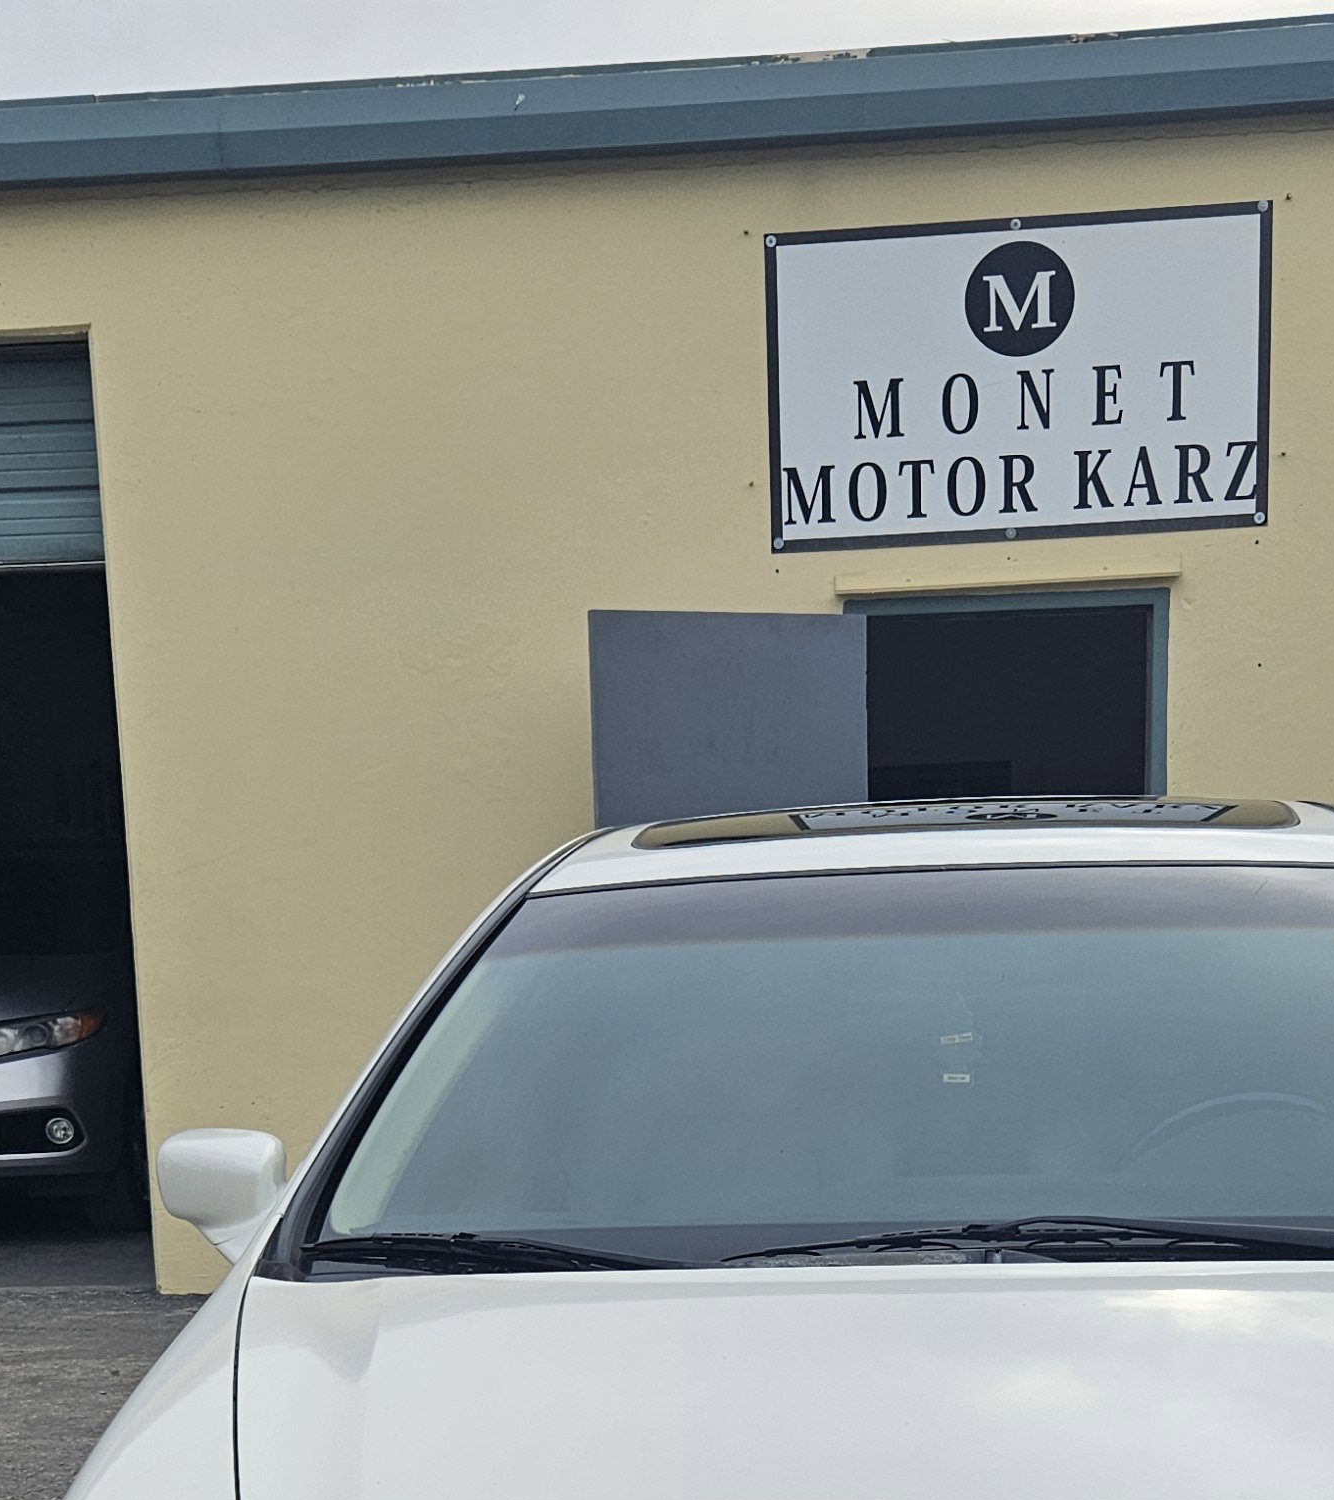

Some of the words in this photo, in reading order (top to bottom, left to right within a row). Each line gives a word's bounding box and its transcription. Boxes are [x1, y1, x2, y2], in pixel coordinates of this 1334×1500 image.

[981, 269, 1057, 333] M
[853, 360, 1196, 440] MONET
[782, 453, 1039, 526] MOTOR
[1072, 440, 1258, 510] KARZ
